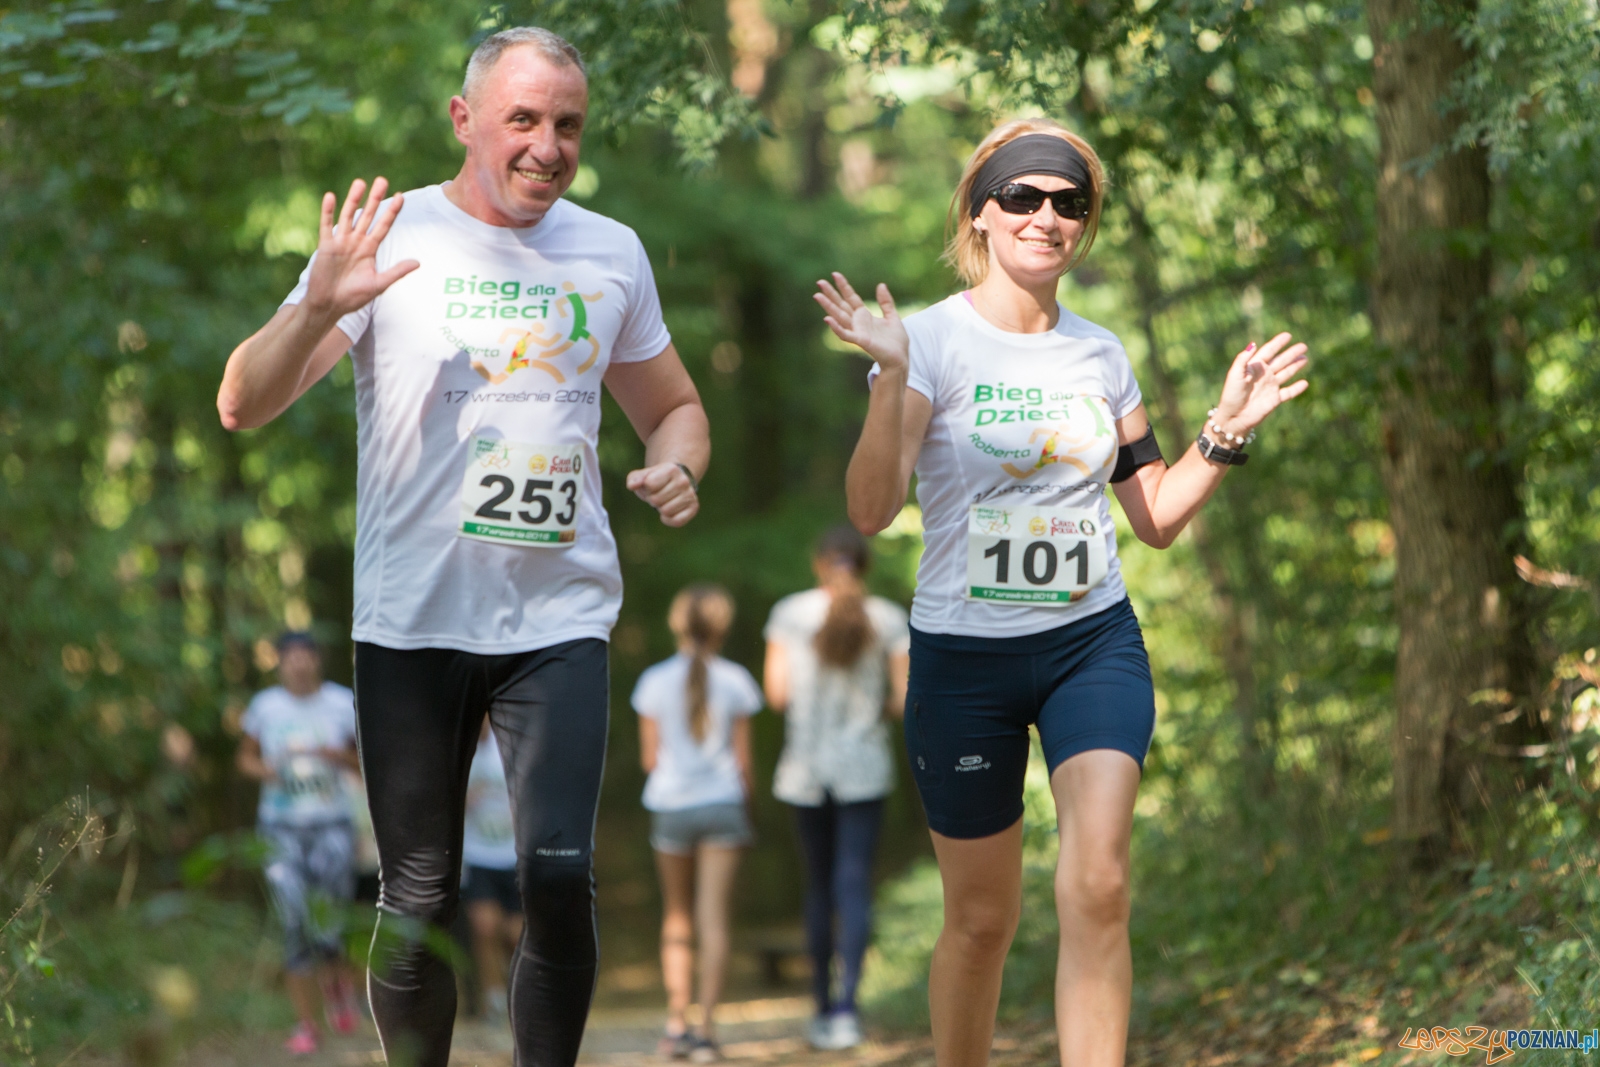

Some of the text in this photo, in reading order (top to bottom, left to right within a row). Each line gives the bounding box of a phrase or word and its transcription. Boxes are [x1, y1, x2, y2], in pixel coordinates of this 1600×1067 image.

[443, 275, 556, 301] Bieg dla
[446, 299, 549, 319] Dzieci
[439, 325, 500, 358] Roberta
[443, 389, 596, 405] 17 września 2016
[974, 382, 1074, 405] Bieg dla
[975, 404, 1070, 427] Dzieci
[968, 432, 1031, 459] Roberta
[474, 474, 577, 526] 253
[984, 539, 1089, 586] 101
[983, 589, 995, 598] 17
